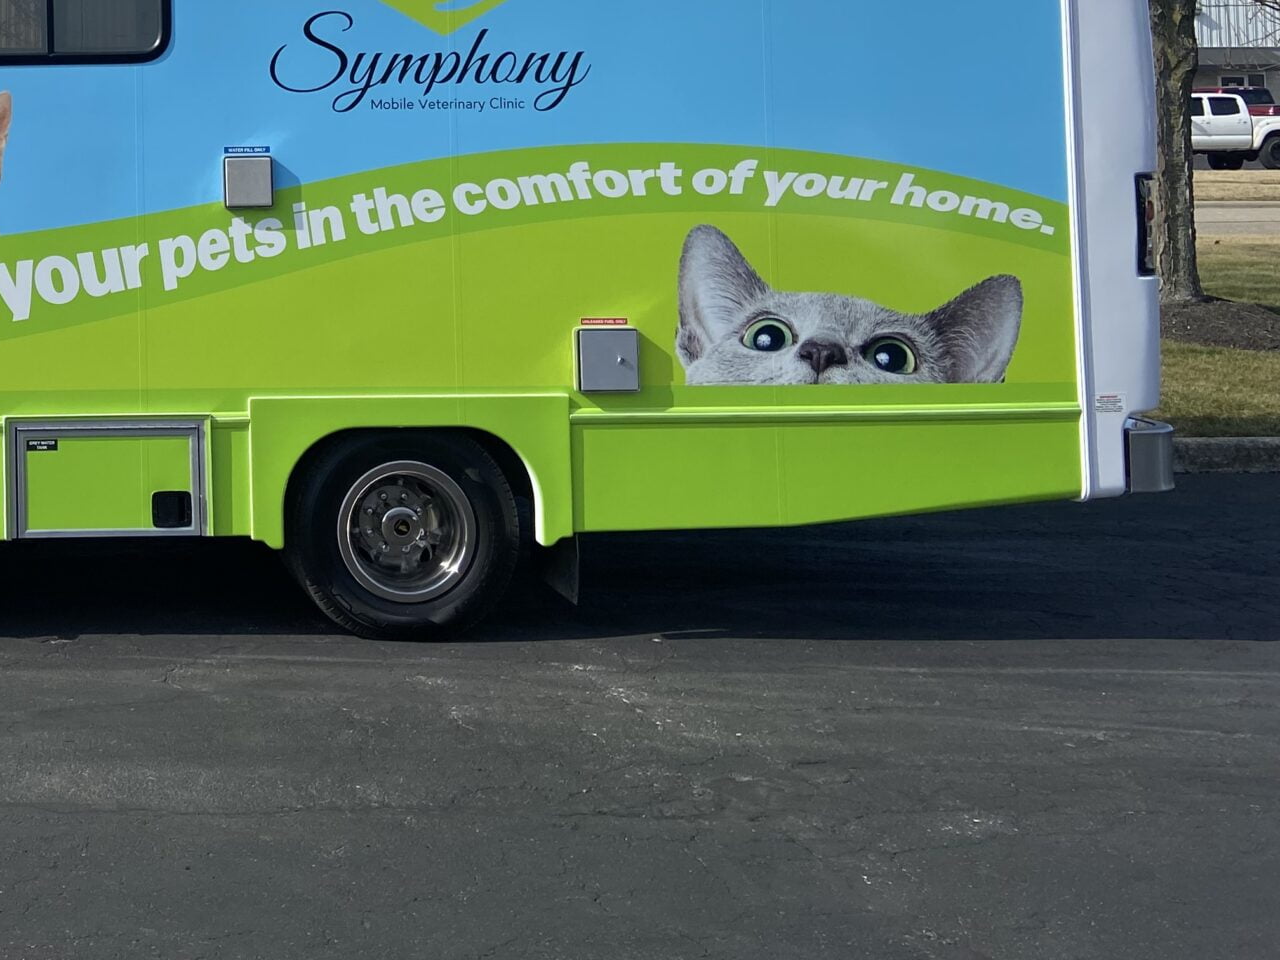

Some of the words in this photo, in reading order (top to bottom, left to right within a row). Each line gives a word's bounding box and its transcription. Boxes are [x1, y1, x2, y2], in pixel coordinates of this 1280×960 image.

[269, 10, 592, 113] Symphony
[370, 98, 414, 110] Mobile
[418, 98, 485, 112] Veterinary
[489, 97, 525, 109] Clinic
[159, 216, 287, 291] pets
[293, 201, 346, 250] in
[351, 187, 446, 235] the
[452, 161, 683, 215] comfort
[692, 159, 758, 195] of
[763, 170, 888, 207] your
[891, 172, 1056, 236] home.
